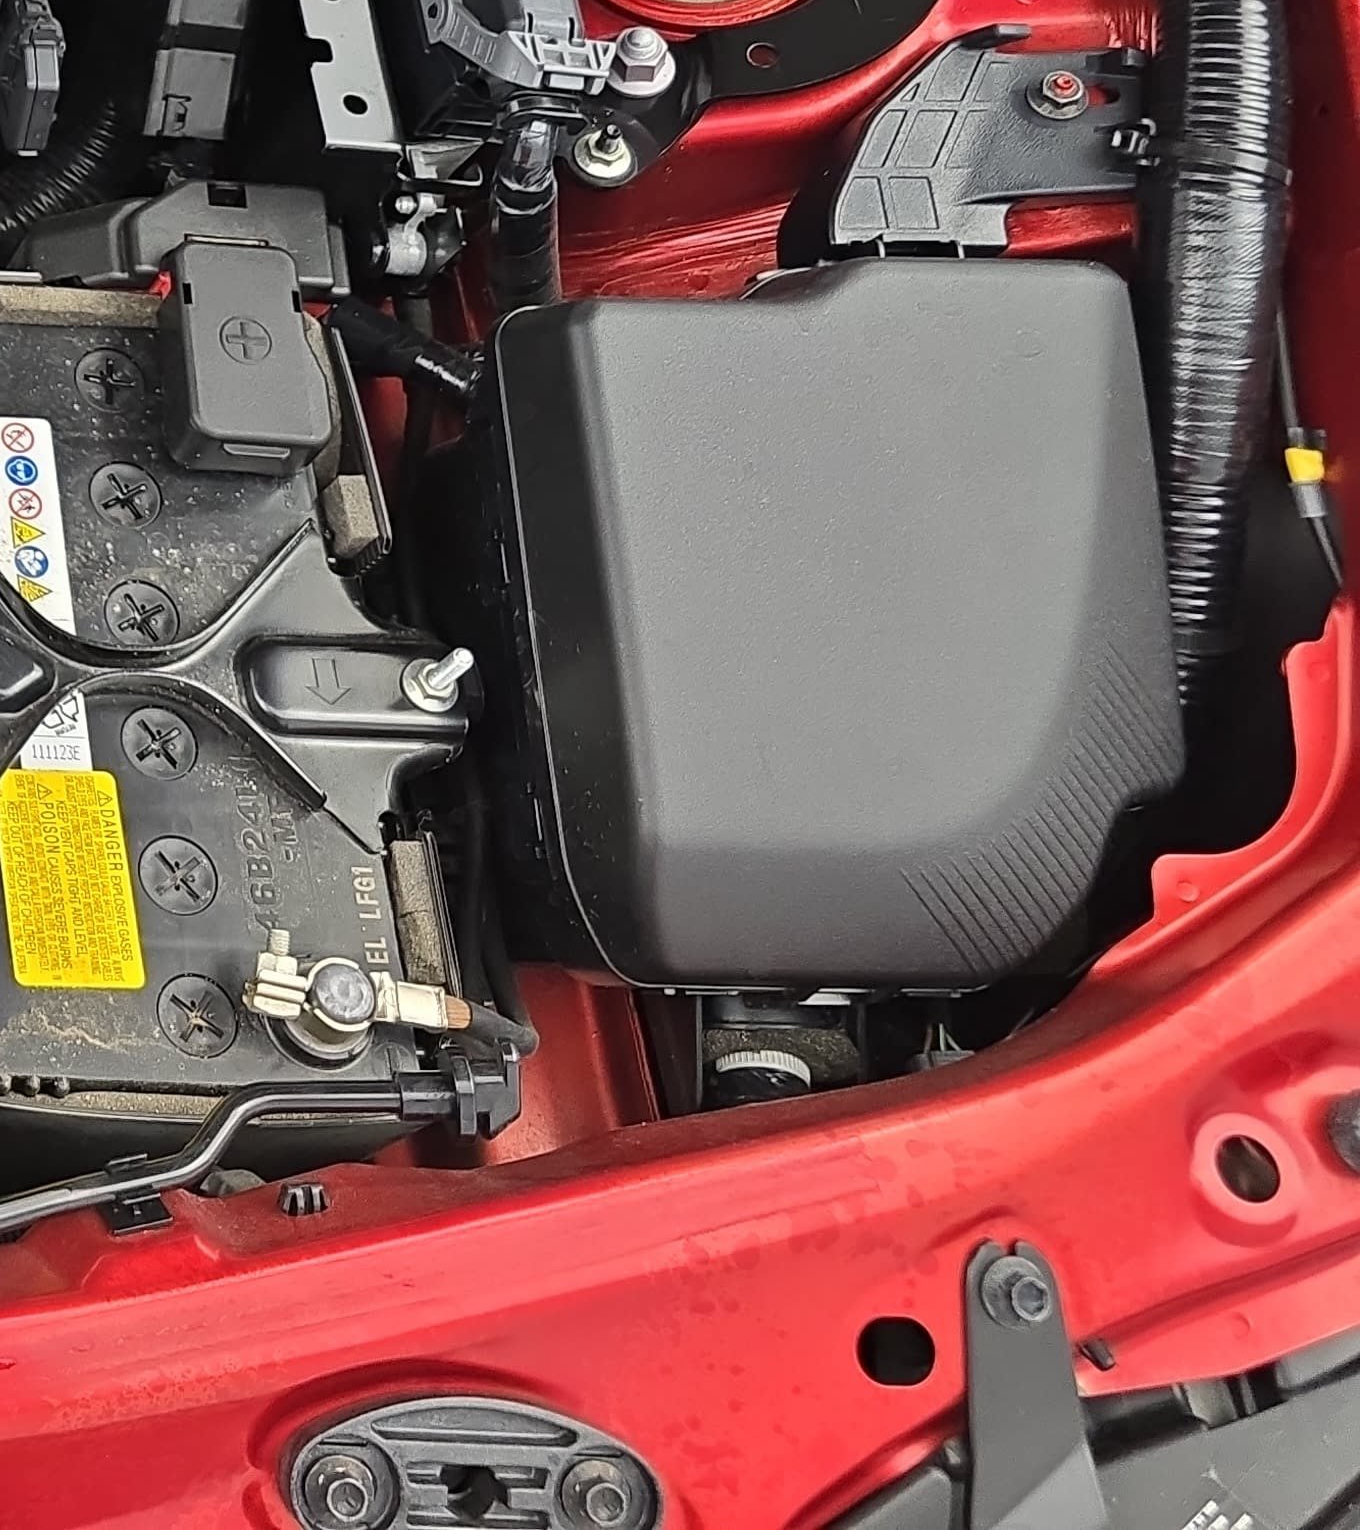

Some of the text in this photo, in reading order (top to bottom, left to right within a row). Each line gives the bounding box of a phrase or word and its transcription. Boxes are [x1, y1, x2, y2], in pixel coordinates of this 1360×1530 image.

[55, 801, 70, 823] KEEP
[59, 827, 73, 849] VENT
[63, 851, 78, 875] CAPS
[7, 801, 38, 954] KEEP OUT OF REACH OF CHILDREN
[39, 803, 74, 969] POISON CAUSES SEVERE BURNS
[100, 810, 134, 961] DANGER EXPLOSIVE GASES
[67, 879, 82, 905] TIGHT
[71, 908, 84, 926] AND
